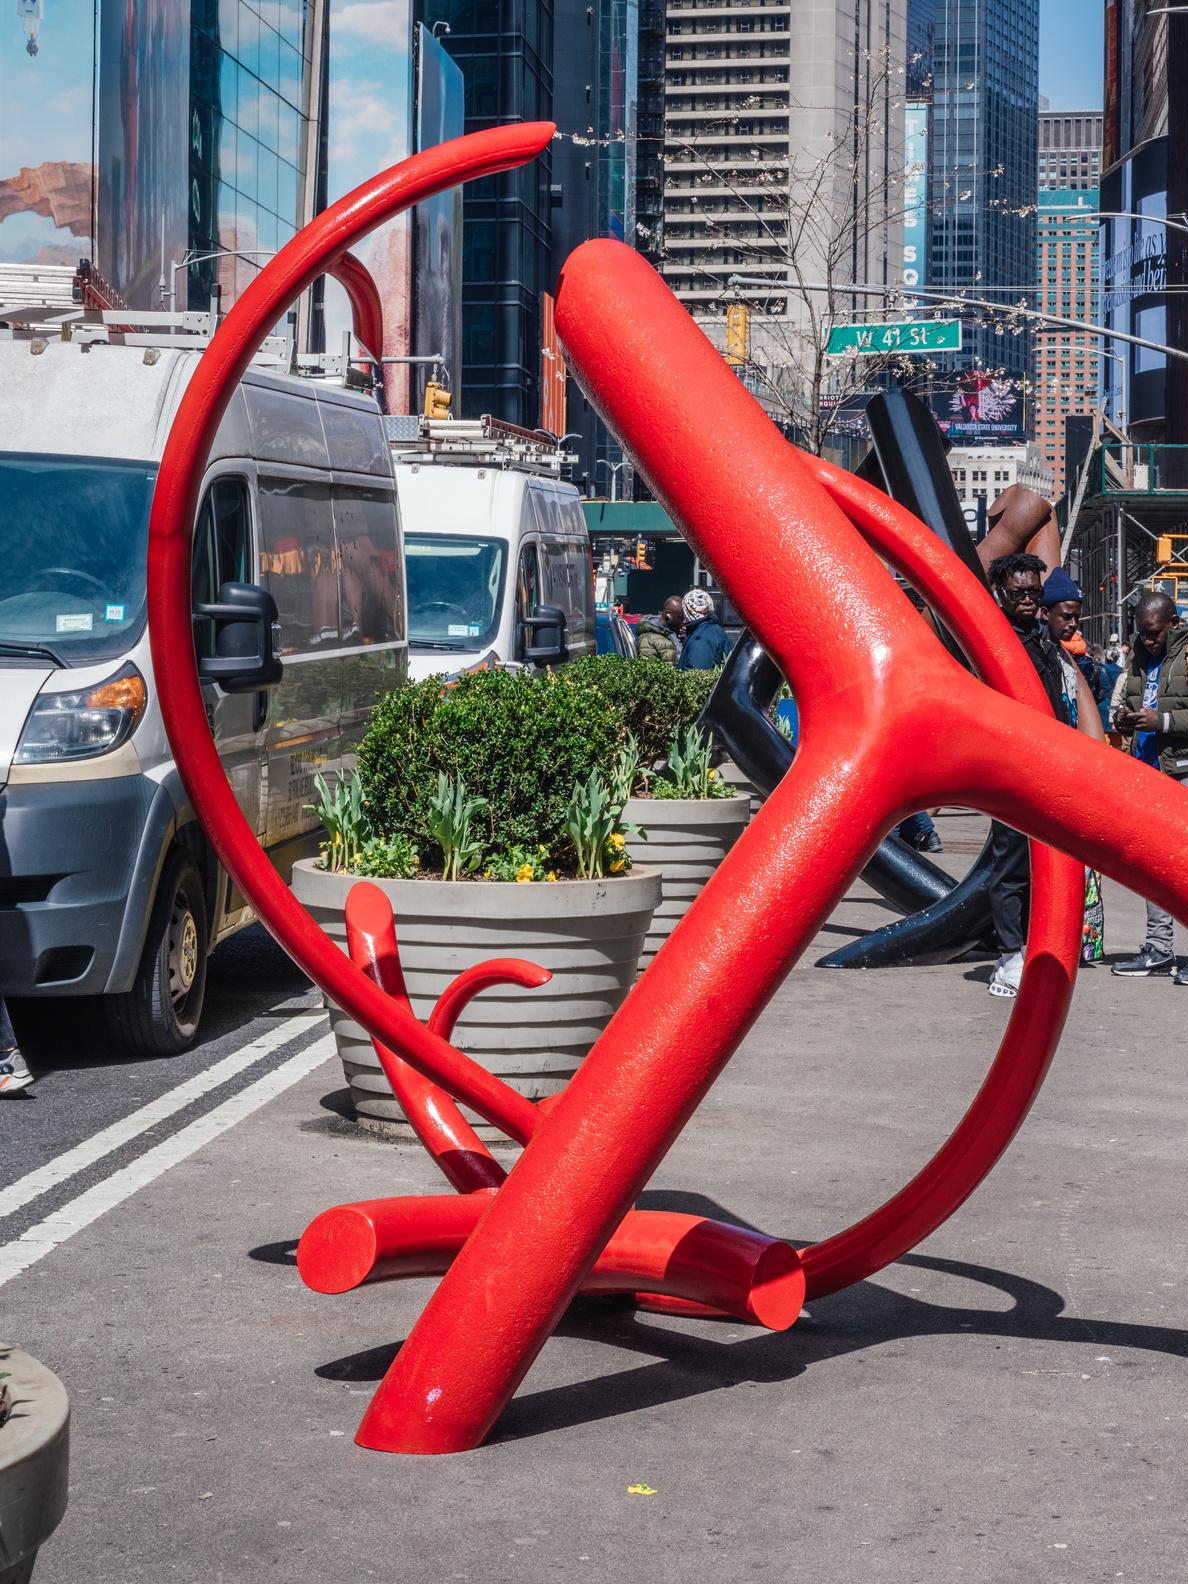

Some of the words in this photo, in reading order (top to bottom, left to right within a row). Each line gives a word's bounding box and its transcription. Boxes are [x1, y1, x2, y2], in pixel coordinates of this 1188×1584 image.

[903, 118, 918, 228] TIMES
[856, 330, 873, 347] W
[882, 328, 901, 347] 41
[910, 327, 928, 345] St
[954, 423, 977, 431] VALDOSTA
[991, 424, 1018, 432] UNIVERSITY
